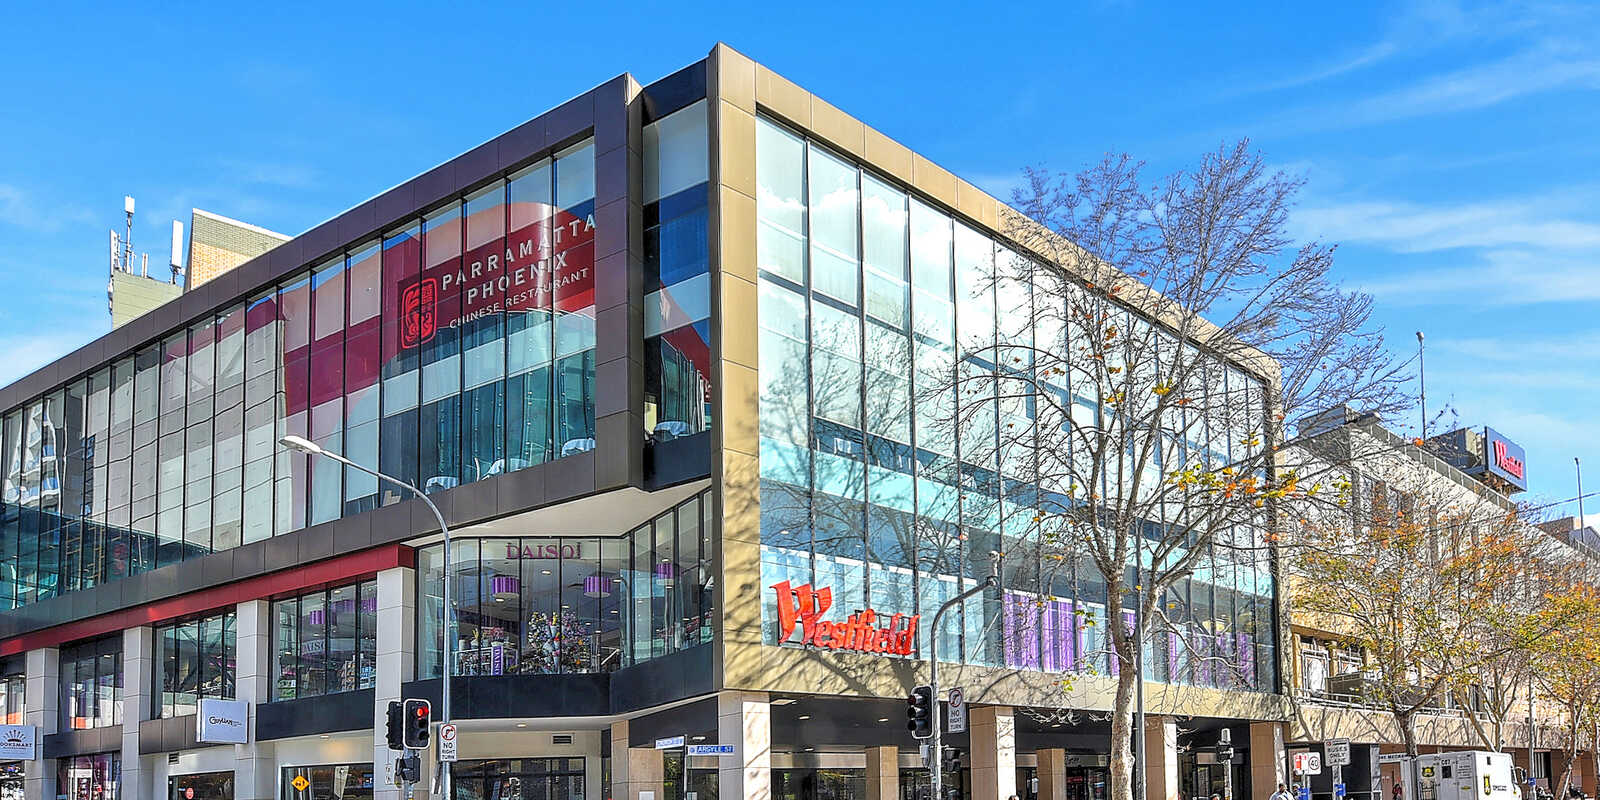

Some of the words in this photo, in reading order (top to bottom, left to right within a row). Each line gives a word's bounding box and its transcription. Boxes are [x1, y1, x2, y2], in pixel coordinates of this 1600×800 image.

[442, 213, 597, 291] PARRAMATTA
[449, 302, 501, 329] CHINESE
[505, 267, 590, 308] RESTAURANT
[467, 250, 569, 305] PHOENIX
[1493, 439, 1524, 480] Westfield
[769, 579, 920, 656] Westfield
[951, 709, 960, 718] NO
[697, 745, 722, 753] ARGYLE
[1310, 759, 1319, 767] 40
